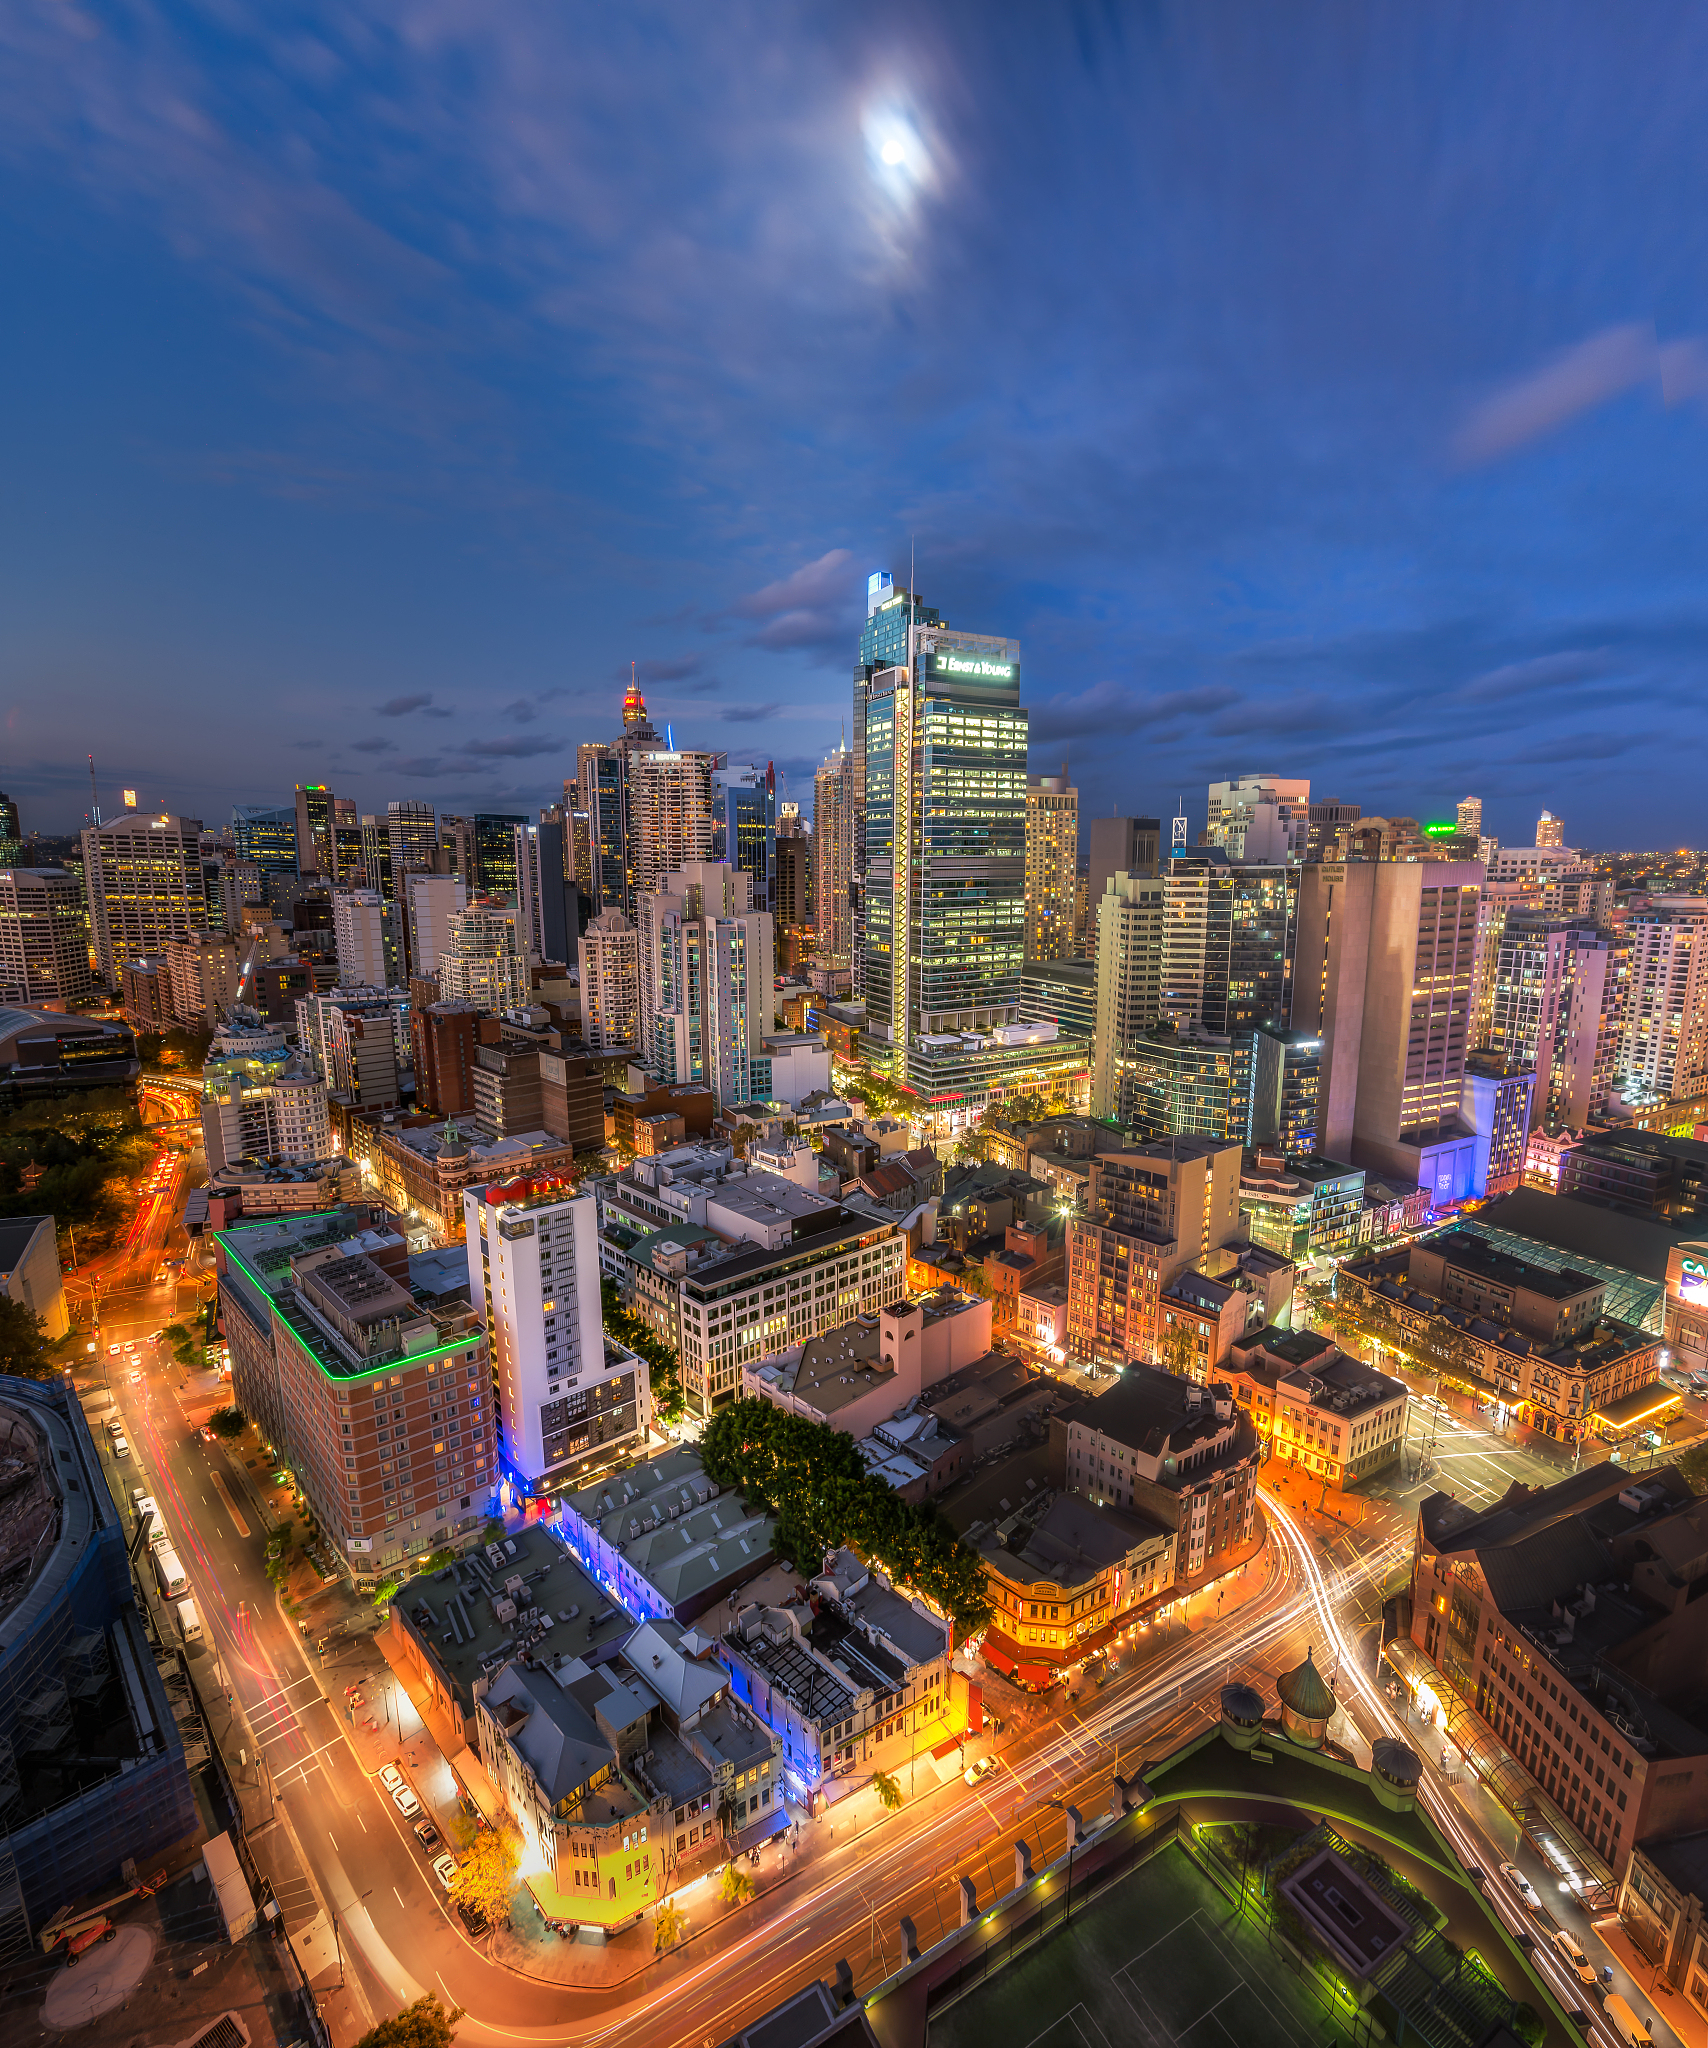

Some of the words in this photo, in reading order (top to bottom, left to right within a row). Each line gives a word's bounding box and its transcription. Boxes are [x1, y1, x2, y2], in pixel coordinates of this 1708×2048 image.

[948, 656, 974, 672] ERNST
[981, 662, 1011, 677] YOUNG
[1321, 865, 1345, 873] CUTLER
[1682, 1259, 1708, 1279] CA
